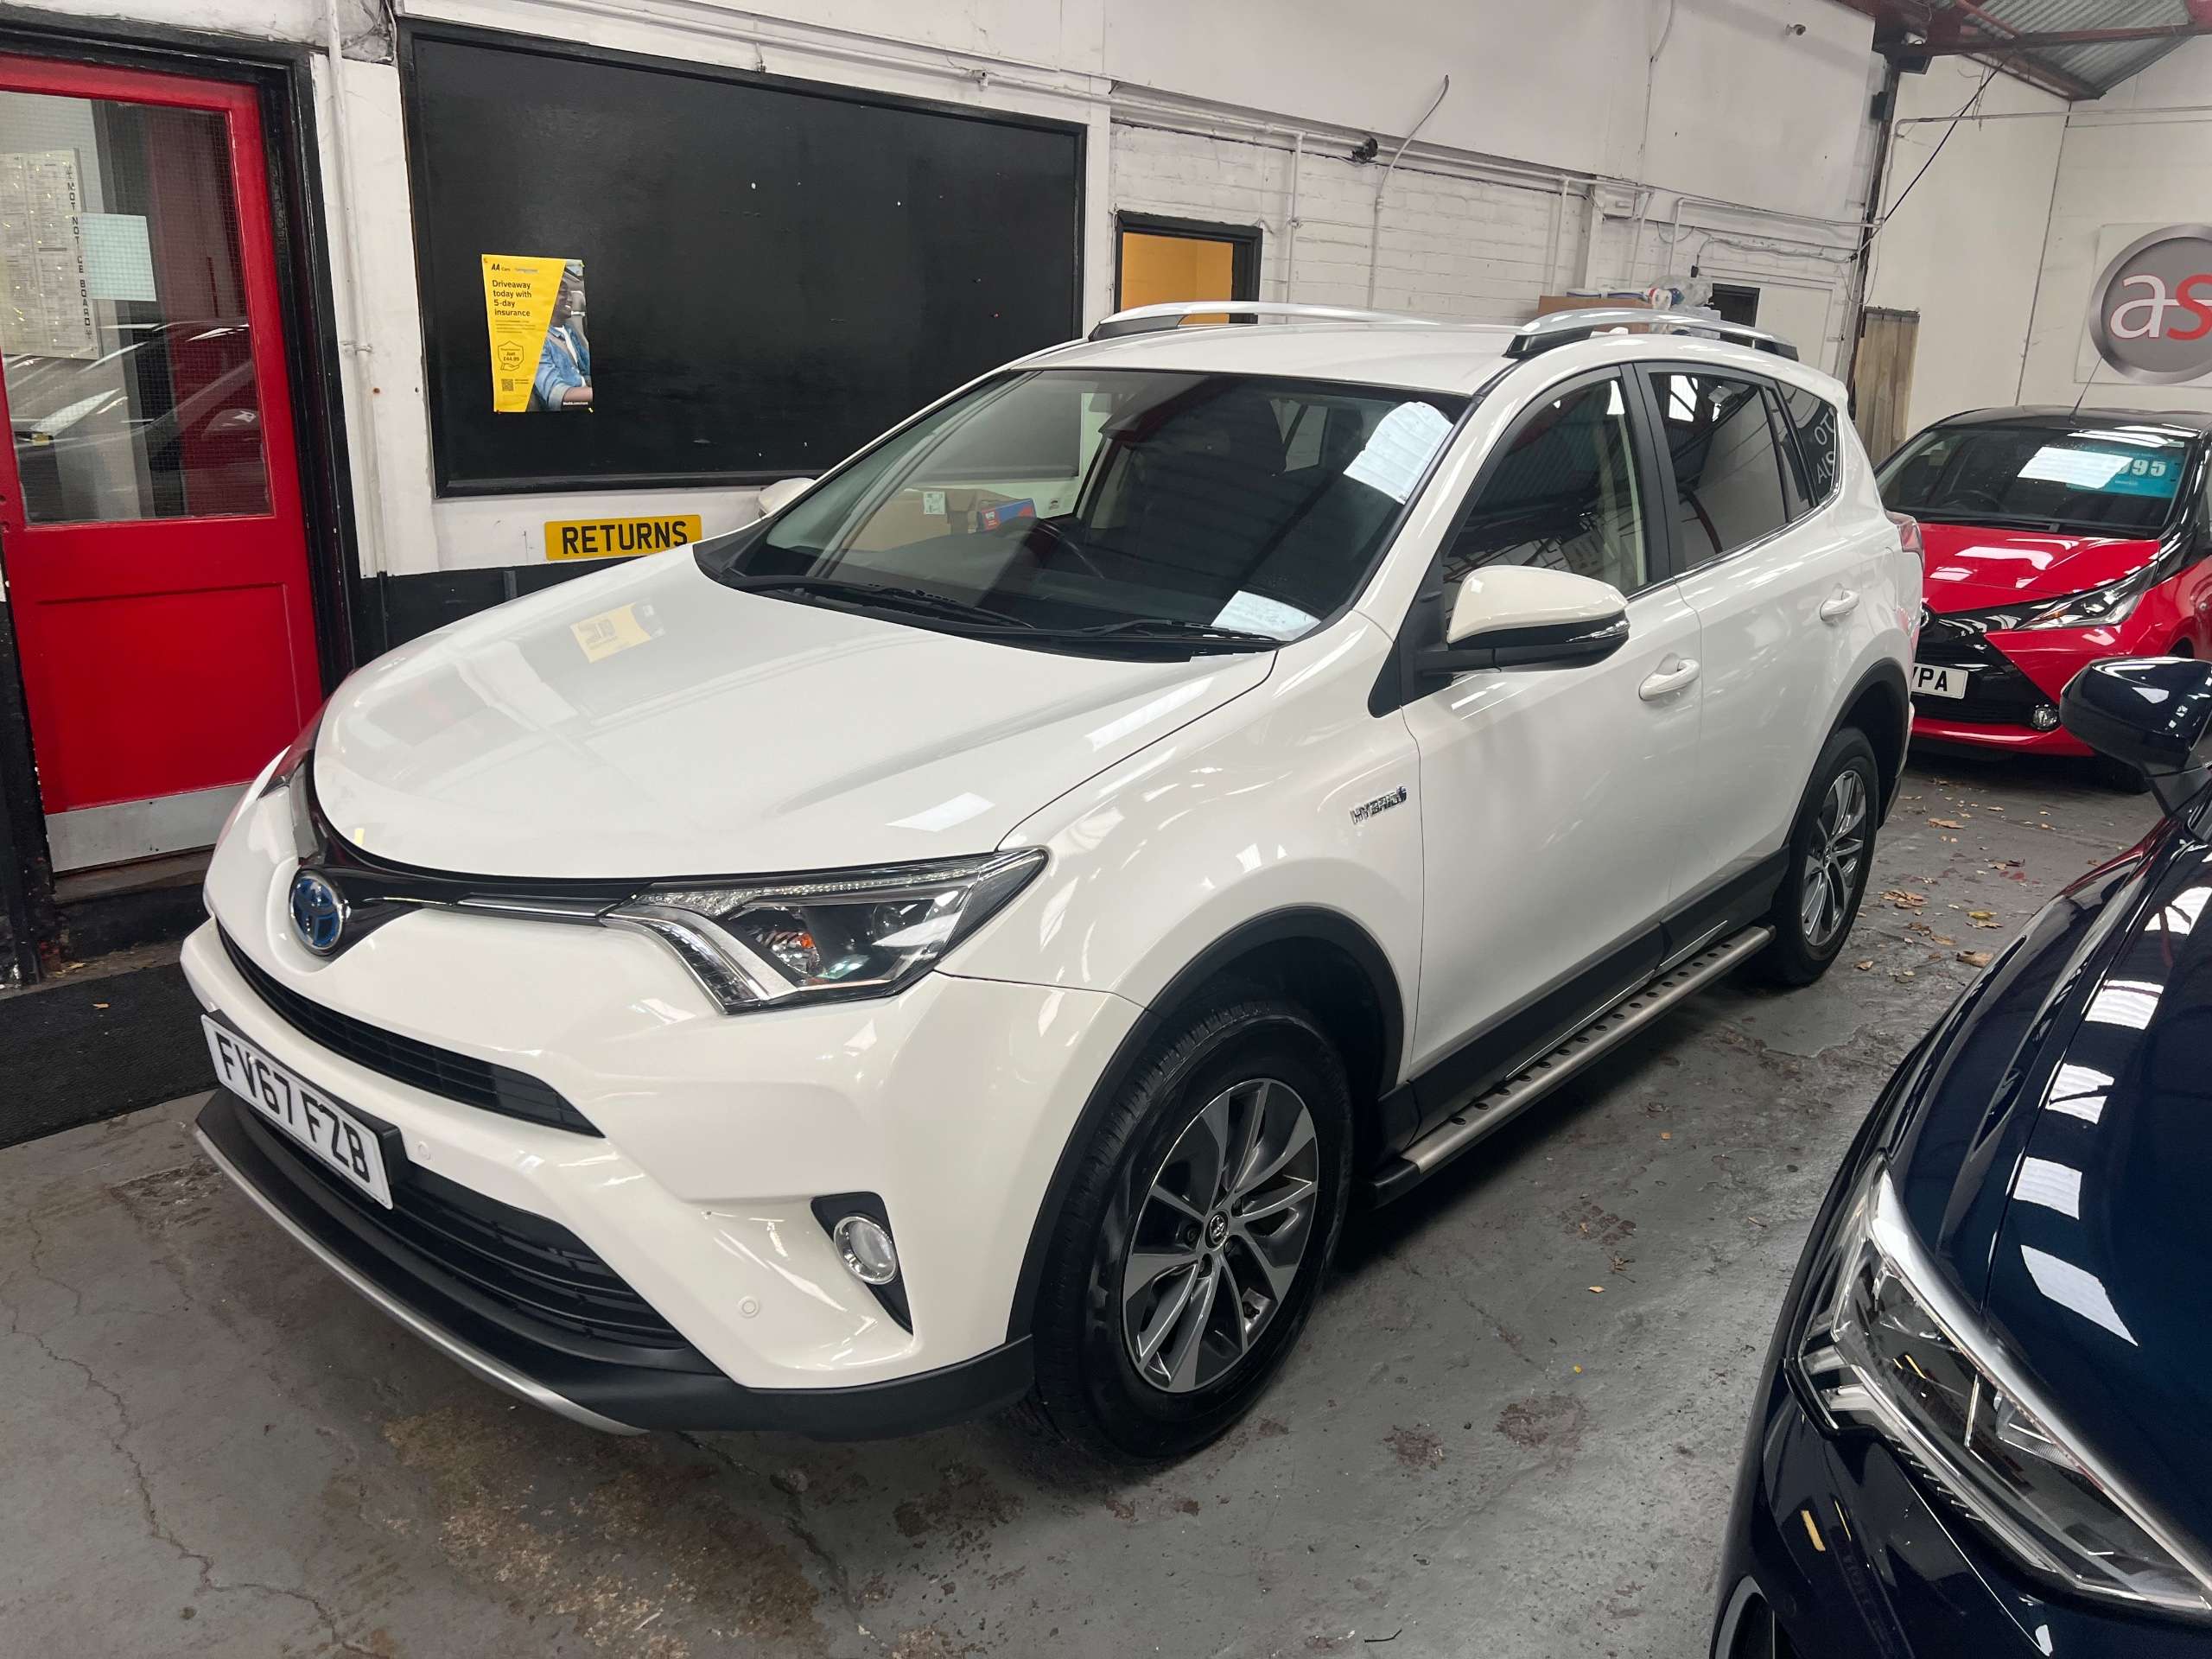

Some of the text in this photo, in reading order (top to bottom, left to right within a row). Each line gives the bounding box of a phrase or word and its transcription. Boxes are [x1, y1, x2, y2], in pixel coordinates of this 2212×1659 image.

[67, 181, 76, 210] MOT
[80, 279, 91, 326] BOARD
[491, 263, 500, 271] AA
[492, 279, 531, 289] Driveaway
[493, 289, 514, 298] today
[493, 299, 516, 308] 5-day
[562, 520, 688, 555] RETURNS
[1350, 791, 1402, 825] HYBRID
